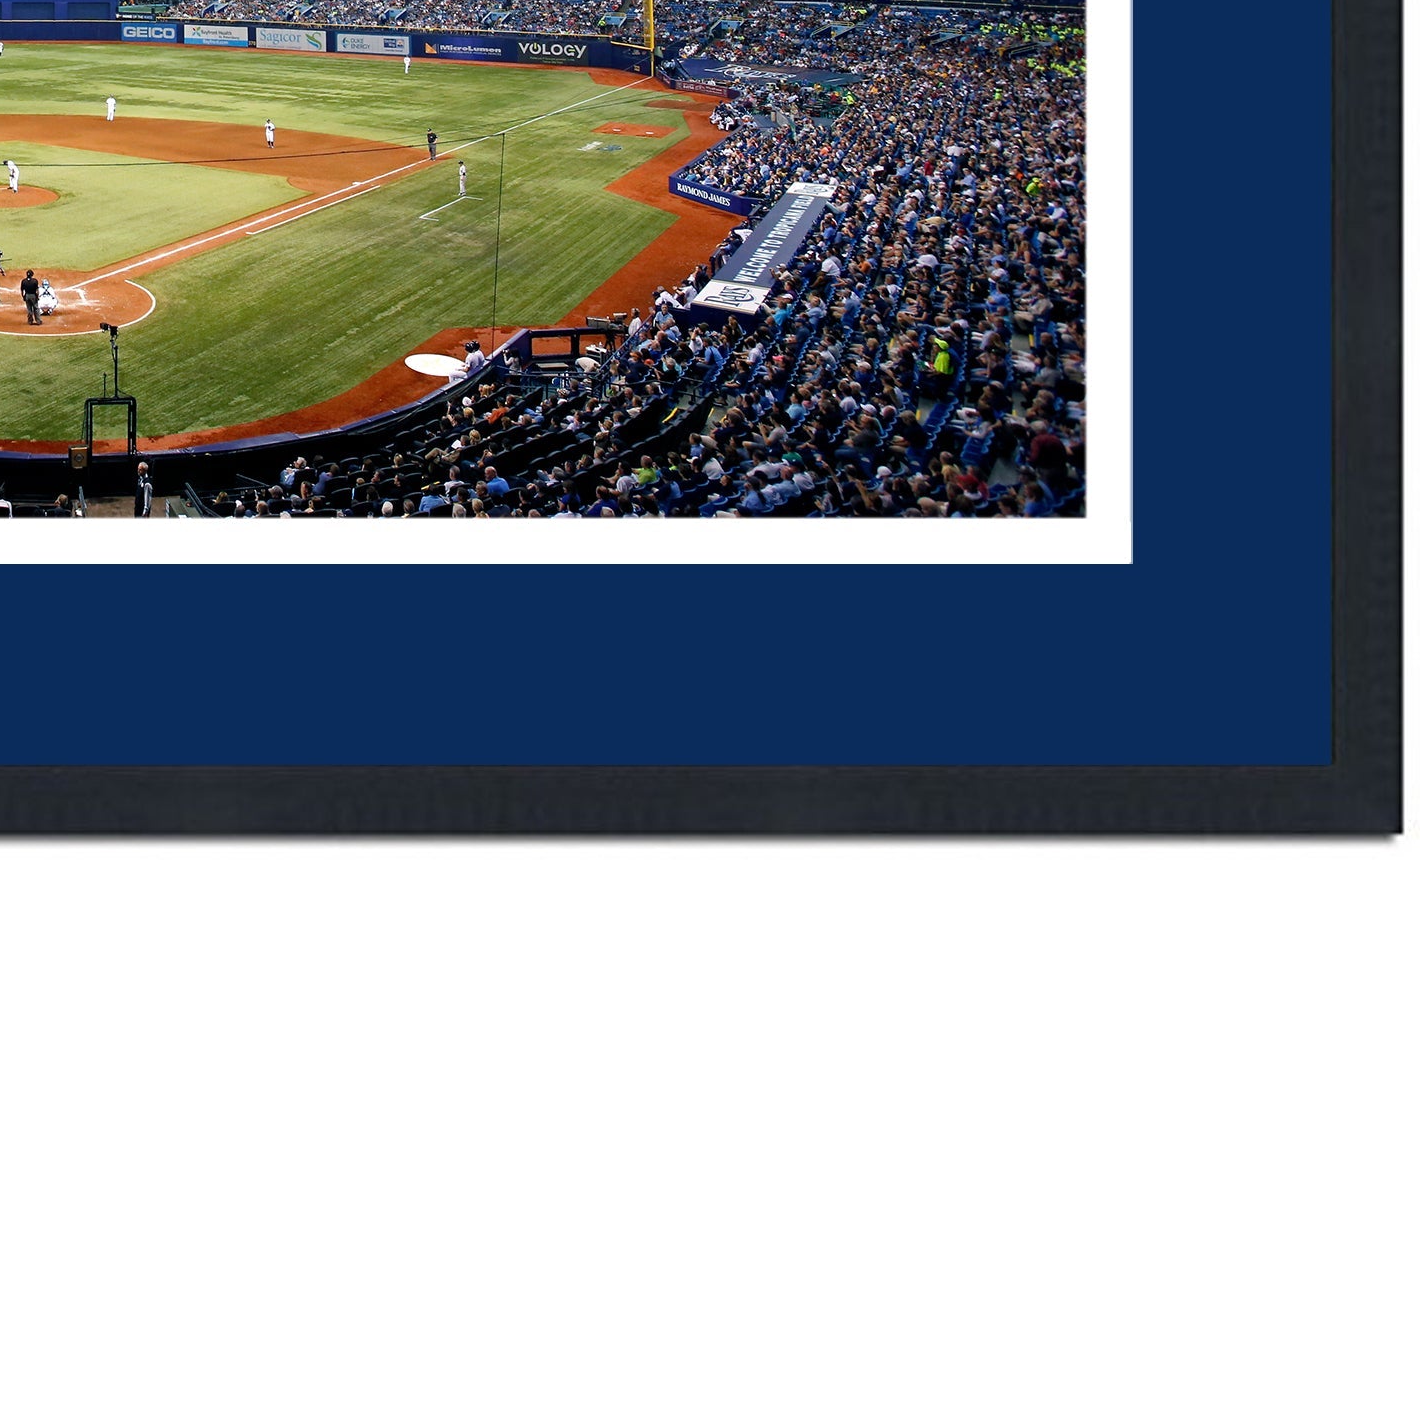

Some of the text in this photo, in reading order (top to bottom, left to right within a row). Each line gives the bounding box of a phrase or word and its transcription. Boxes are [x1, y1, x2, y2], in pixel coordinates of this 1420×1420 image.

[123, 26, 175, 39] GEICO
[260, 29, 301, 44] Sagicor
[518, 42, 587, 59] VOLOGY
[676, 182, 731, 207] RAYMOND JAMES
[733, 248, 777, 283] WELCOME
[760, 239, 783, 251] TO
